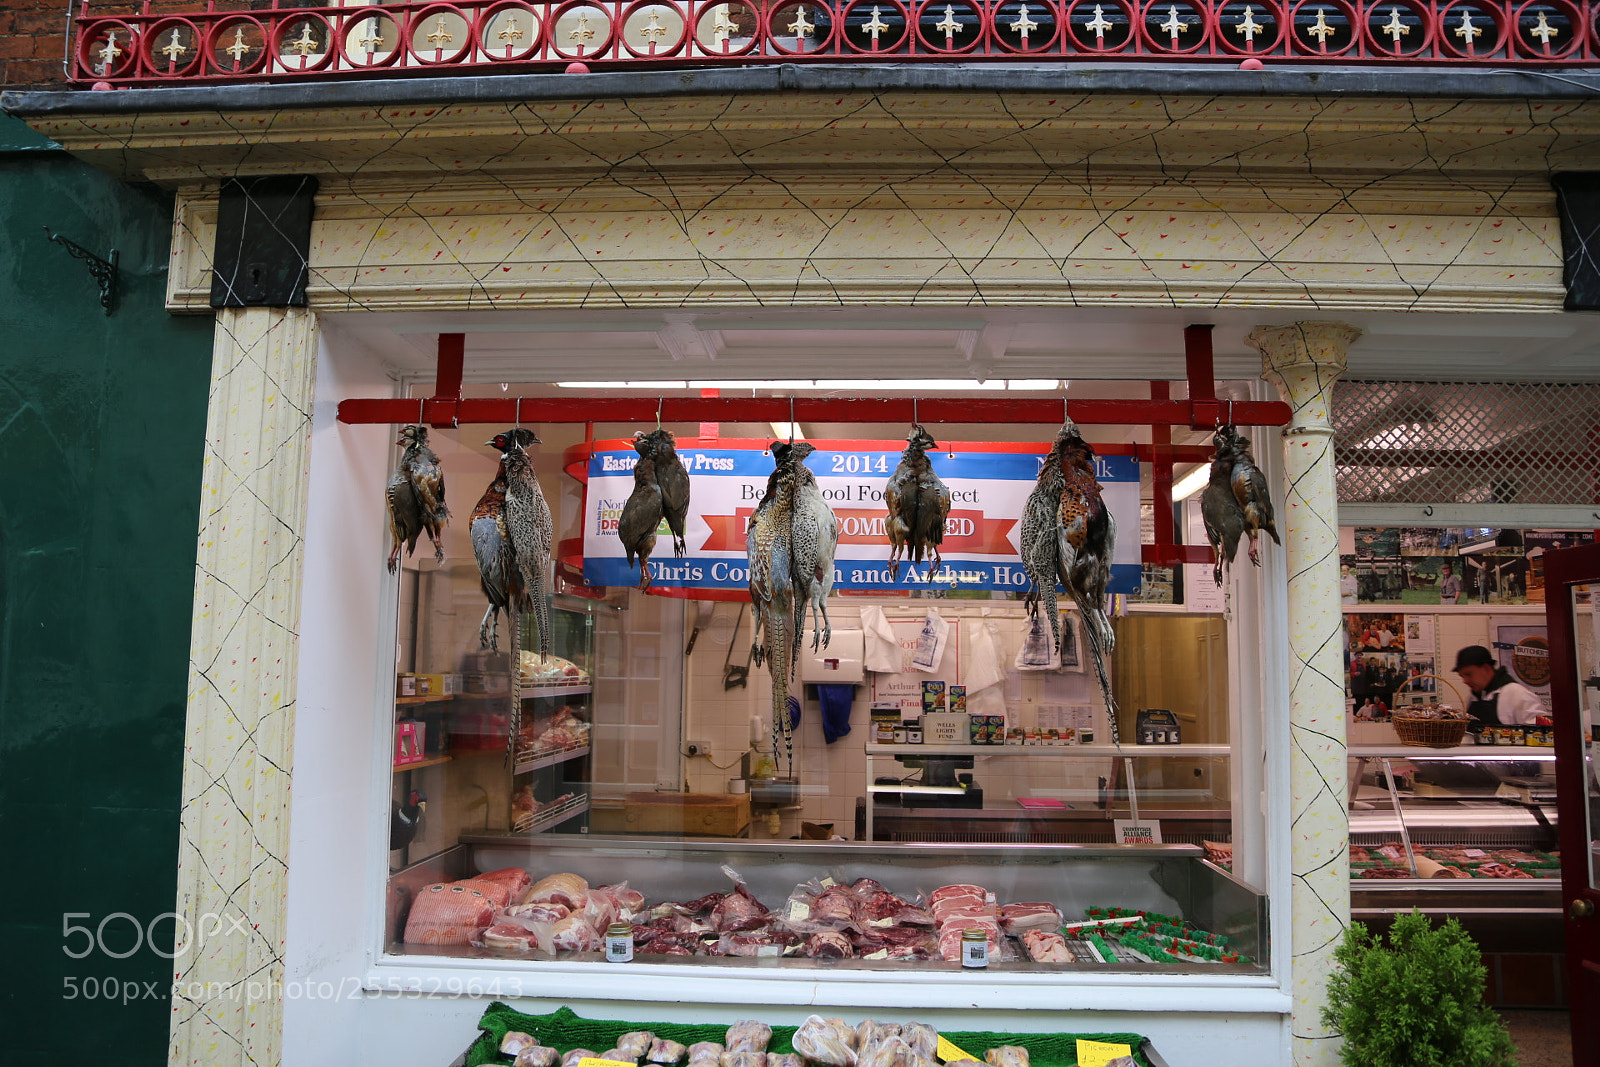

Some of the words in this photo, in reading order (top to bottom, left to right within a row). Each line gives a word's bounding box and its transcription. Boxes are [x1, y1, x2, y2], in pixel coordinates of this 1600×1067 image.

[602, 454, 640, 471] Easte
[695, 454, 734, 470] Press
[831, 454, 889, 473] 2014
[741, 484, 765, 500] Be
[822, 485, 850, 501] ool
[850, 565, 893, 583] and
[1125, 836, 1153, 844] AWARDS
